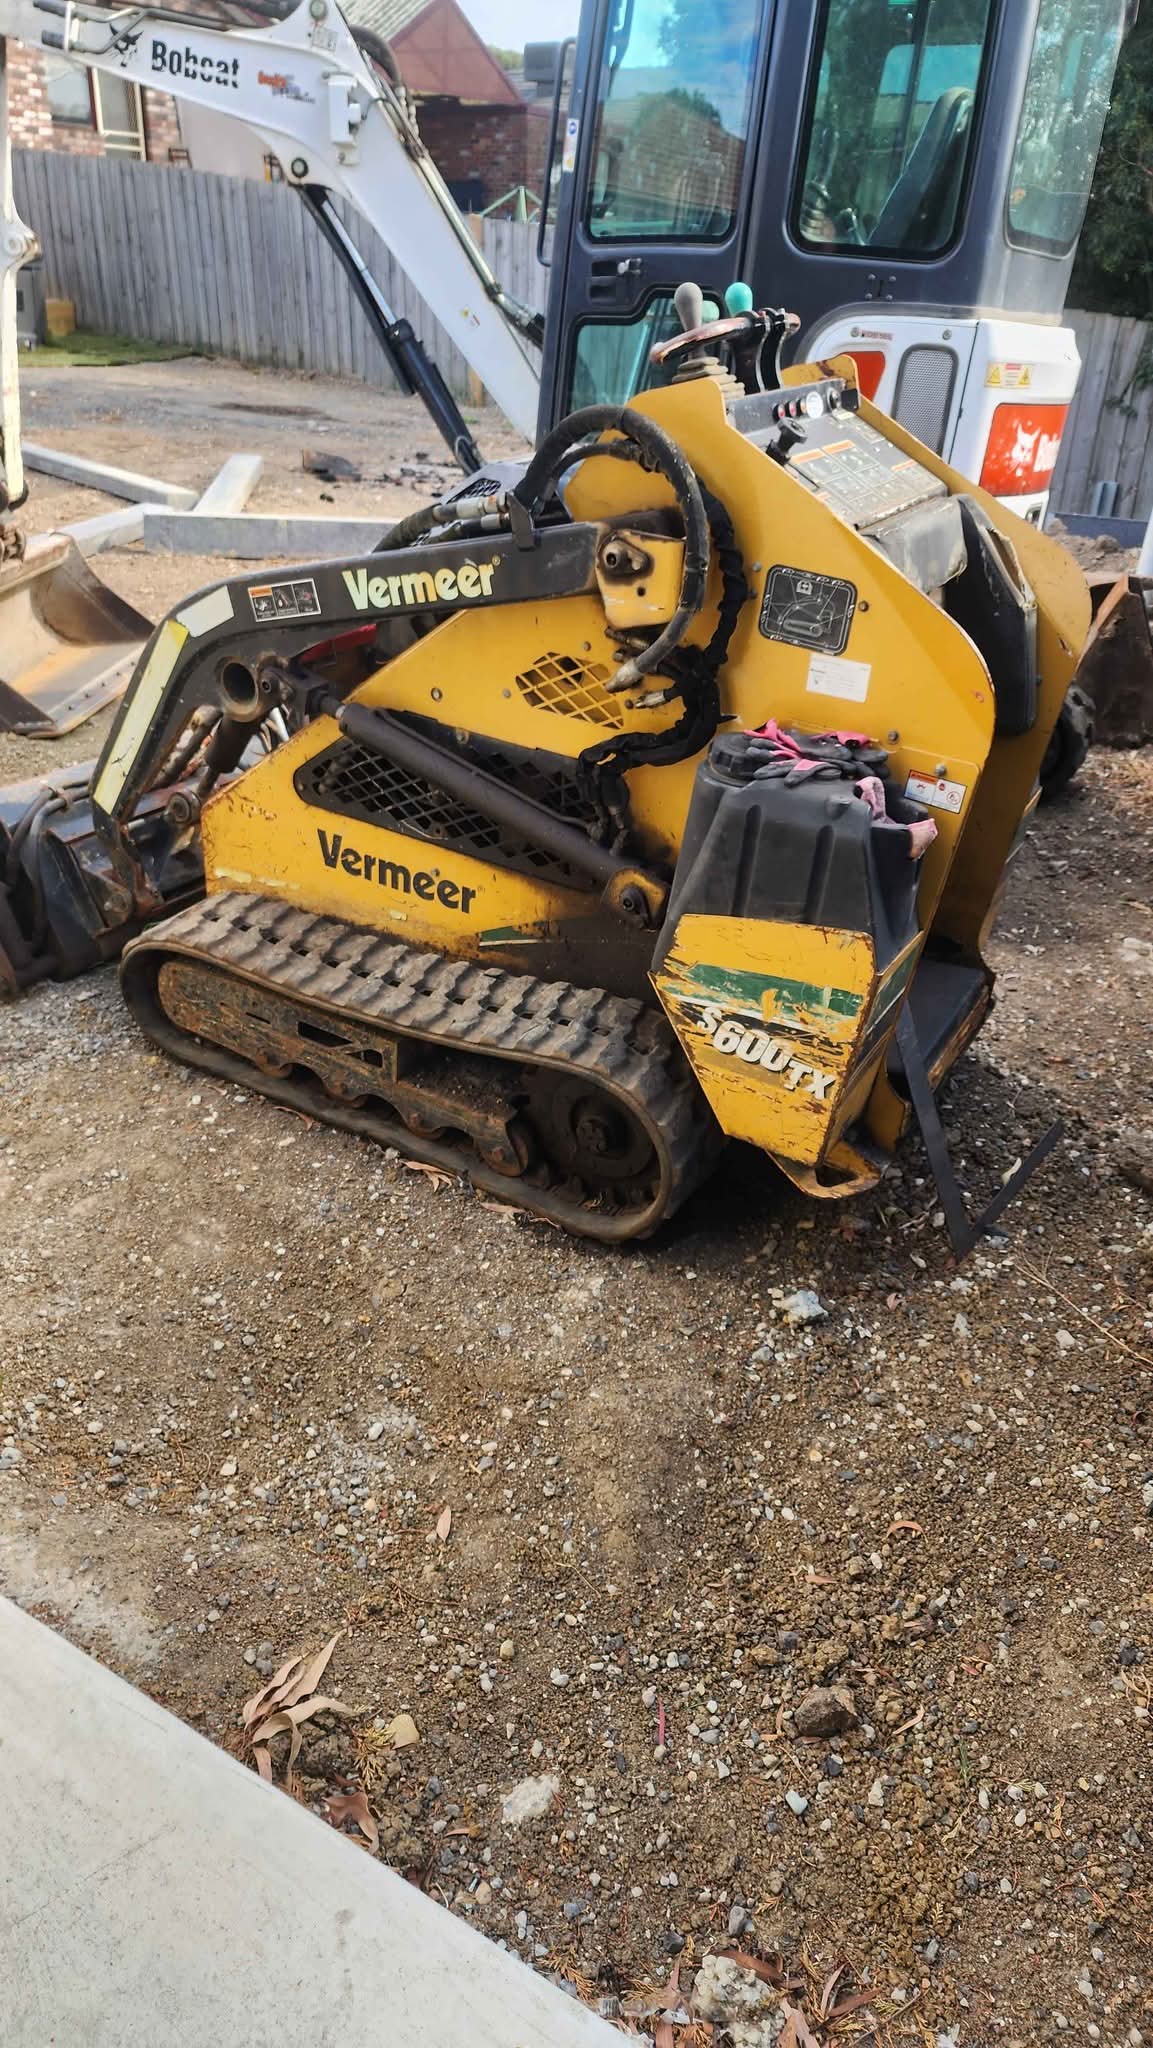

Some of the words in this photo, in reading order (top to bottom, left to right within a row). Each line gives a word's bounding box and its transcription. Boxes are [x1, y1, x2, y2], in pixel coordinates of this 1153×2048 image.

[151, 39, 239, 88] Bobcat
[341, 563, 495, 610] Vermeer
[317, 828, 476, 914] Vermeer
